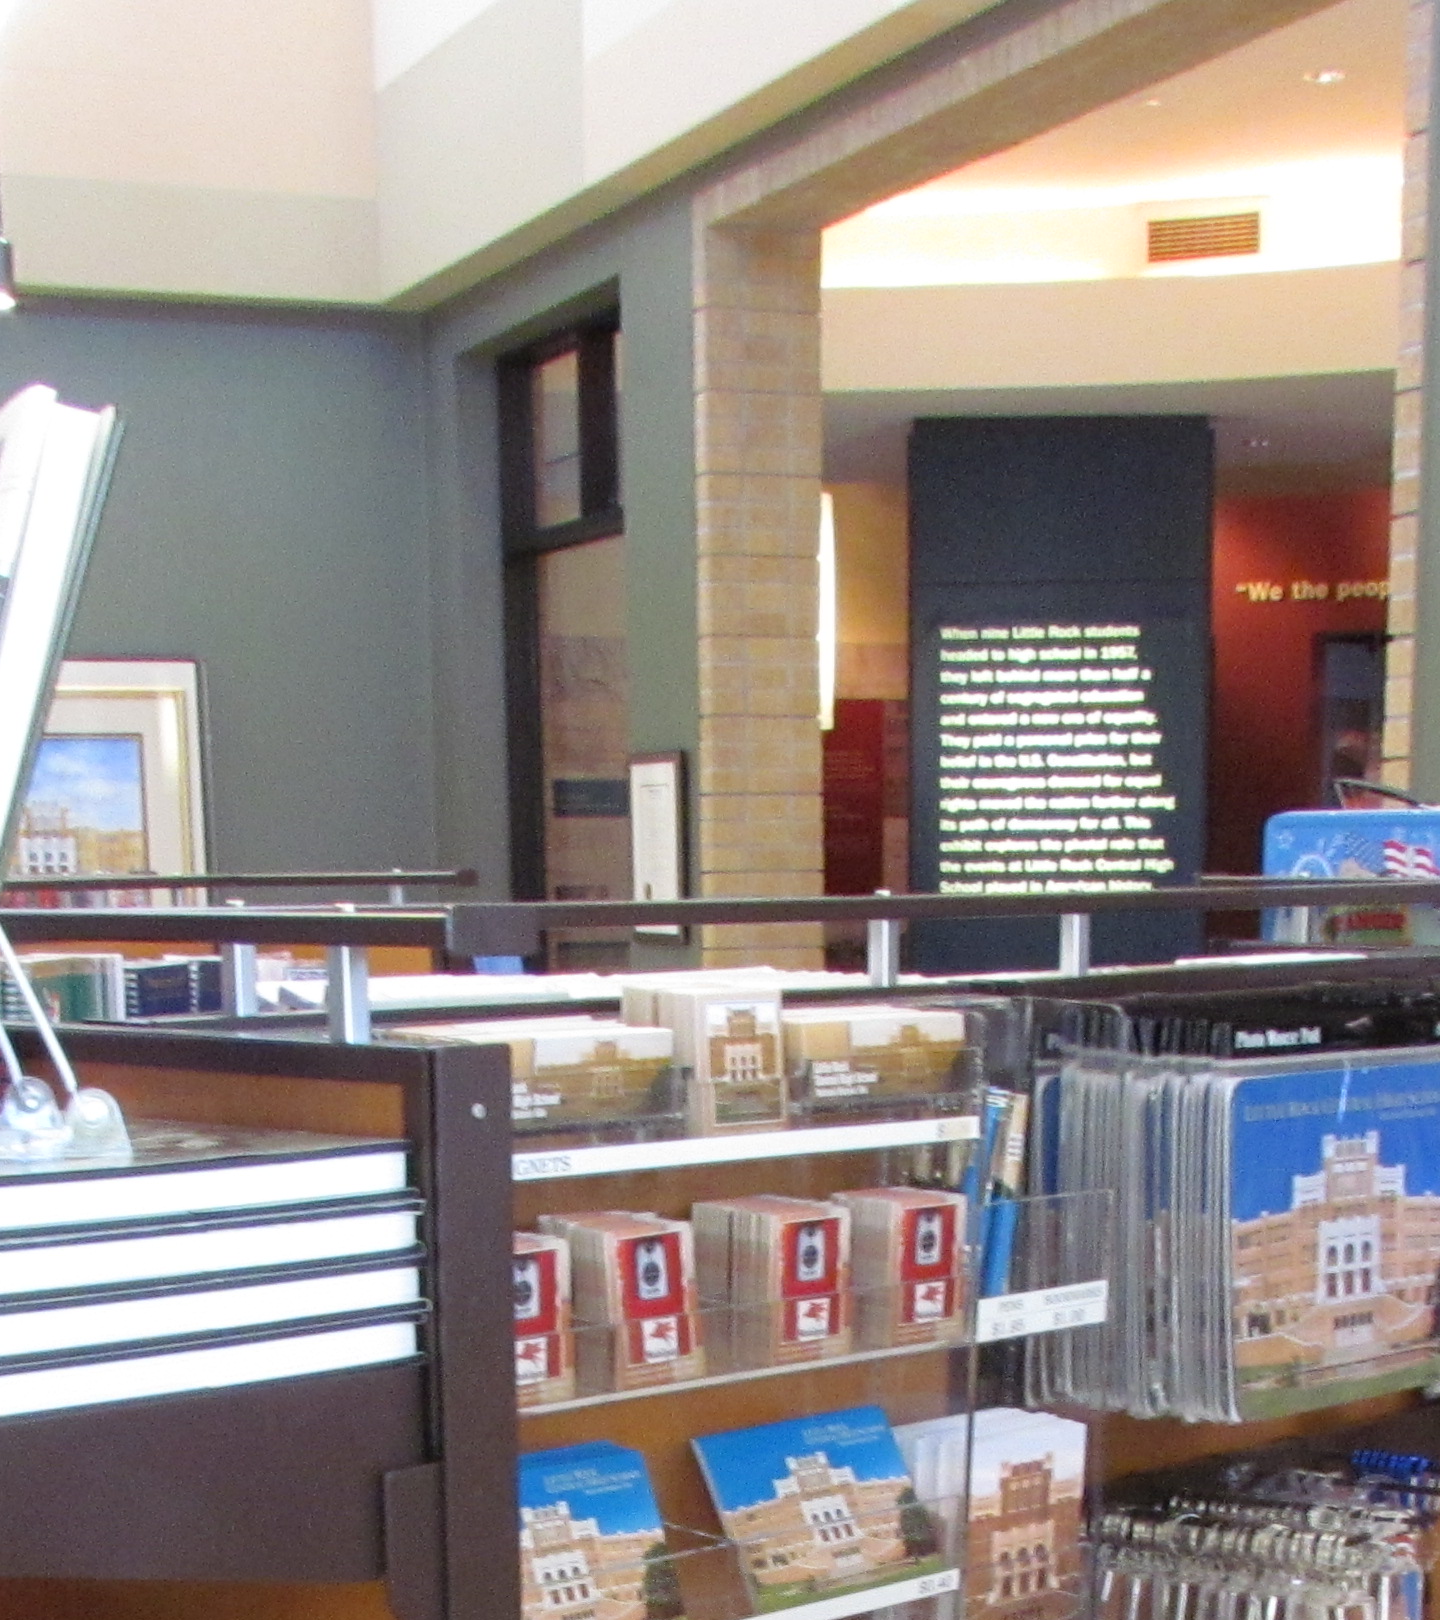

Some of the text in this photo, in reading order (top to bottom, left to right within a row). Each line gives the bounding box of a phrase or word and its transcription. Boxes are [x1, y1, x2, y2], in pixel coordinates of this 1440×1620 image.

[1291, 580, 1329, 601] the
[1012, 625, 1045, 639] Little
[1048, 625, 1081, 639] Rock
